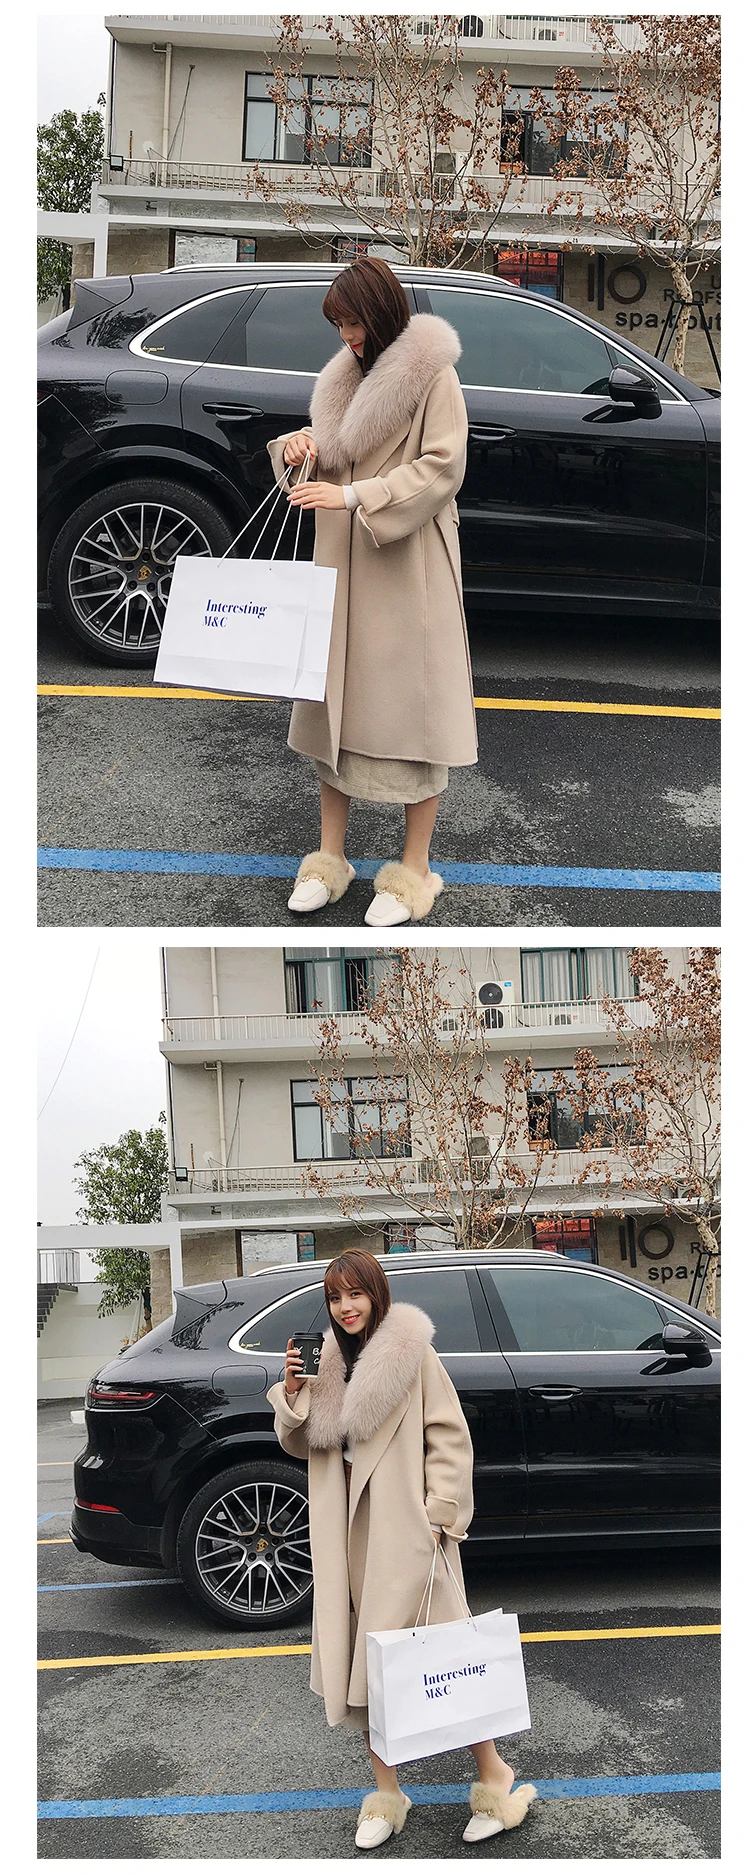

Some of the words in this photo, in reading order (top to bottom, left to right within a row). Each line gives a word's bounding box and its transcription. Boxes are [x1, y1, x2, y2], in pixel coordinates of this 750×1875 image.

[206, 598, 268, 619] Interesting
[202, 615, 228, 628] M&C
[423, 1663, 487, 1686] Interesting
[425, 1684, 452, 1700] M&C
